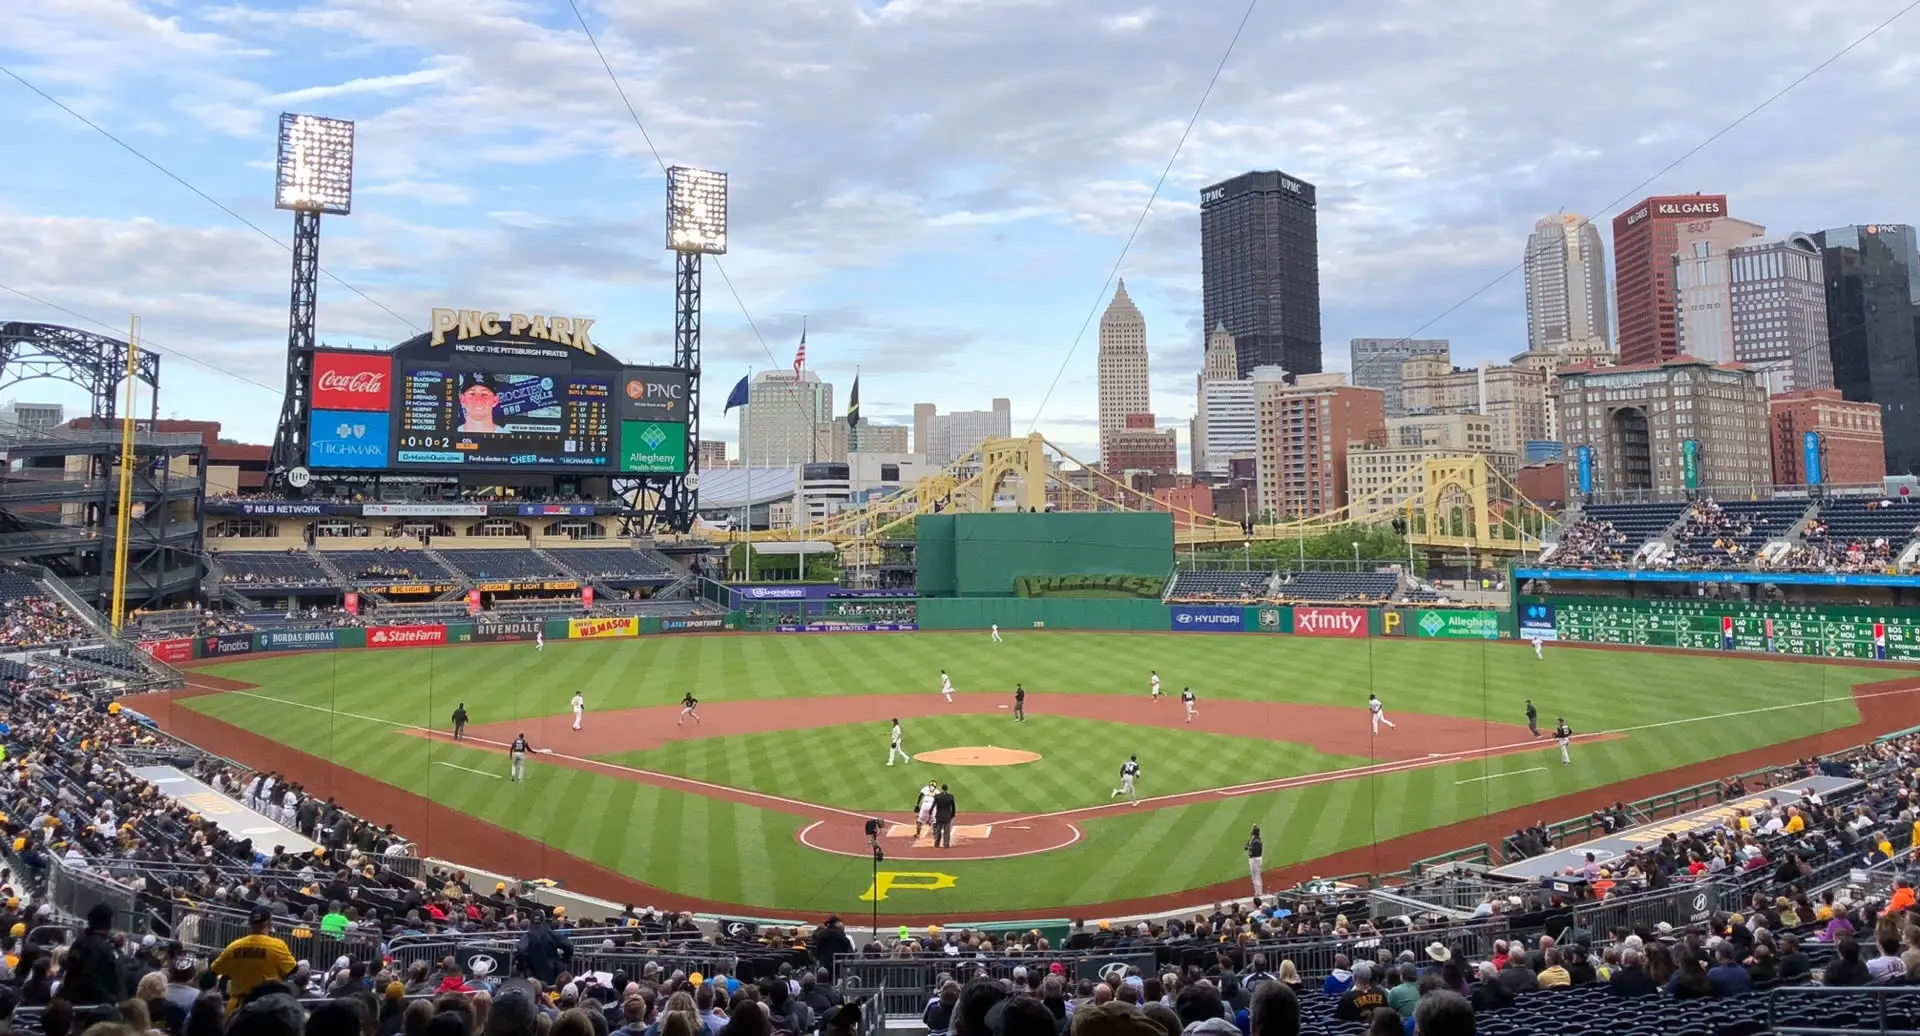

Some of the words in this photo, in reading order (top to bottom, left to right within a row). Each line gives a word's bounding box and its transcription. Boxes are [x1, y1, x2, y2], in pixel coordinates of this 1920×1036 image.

[1281, 177, 1301, 195] UPMC
[1200, 187, 1225, 203] UPMC
[1659, 204, 1680, 214] K&L
[1682, 203, 1720, 214] GATES
[1878, 225, 1898, 233] PNC
[430, 307, 503, 348] PNC
[510, 313, 597, 357] PARK
[456, 344, 476, 353] HOME
[487, 346, 500, 354] THE
[501, 347, 541, 356] PITTSBURGH
[542, 349, 569, 359] PIRATES
[646, 384, 682, 399] PNC
[408, 436, 416, 447] 0
[425, 437, 433, 447] 0
[442, 437, 449, 448] 2
[510, 455, 537, 463] CHEER
[630, 452, 675, 464] Allegheny
[255, 505, 274, 514] MLB
[277, 505, 321, 514] NETWORK
[1568, 605, 1636, 613] NATIONAL
[1649, 608, 1704, 616] LEAGUE
[686, 620, 722, 628] SPORTSNET
[1195, 615, 1240, 623] HYUNDAI
[1299, 610, 1362, 633] xfinity
[1384, 612, 1400, 635] P
[1448, 616, 1498, 629] Allegheny
[1740, 611, 1826, 621] AMERICAN
[1842, 615, 1911, 625] LEAGUE
[478, 623, 539, 635] RIVENDALE
[272, 632, 300, 643] BORDAS
[304, 631, 335, 642] BORDAS
[217, 640, 249, 652] Fanatics
[858, 871, 959, 901] P
